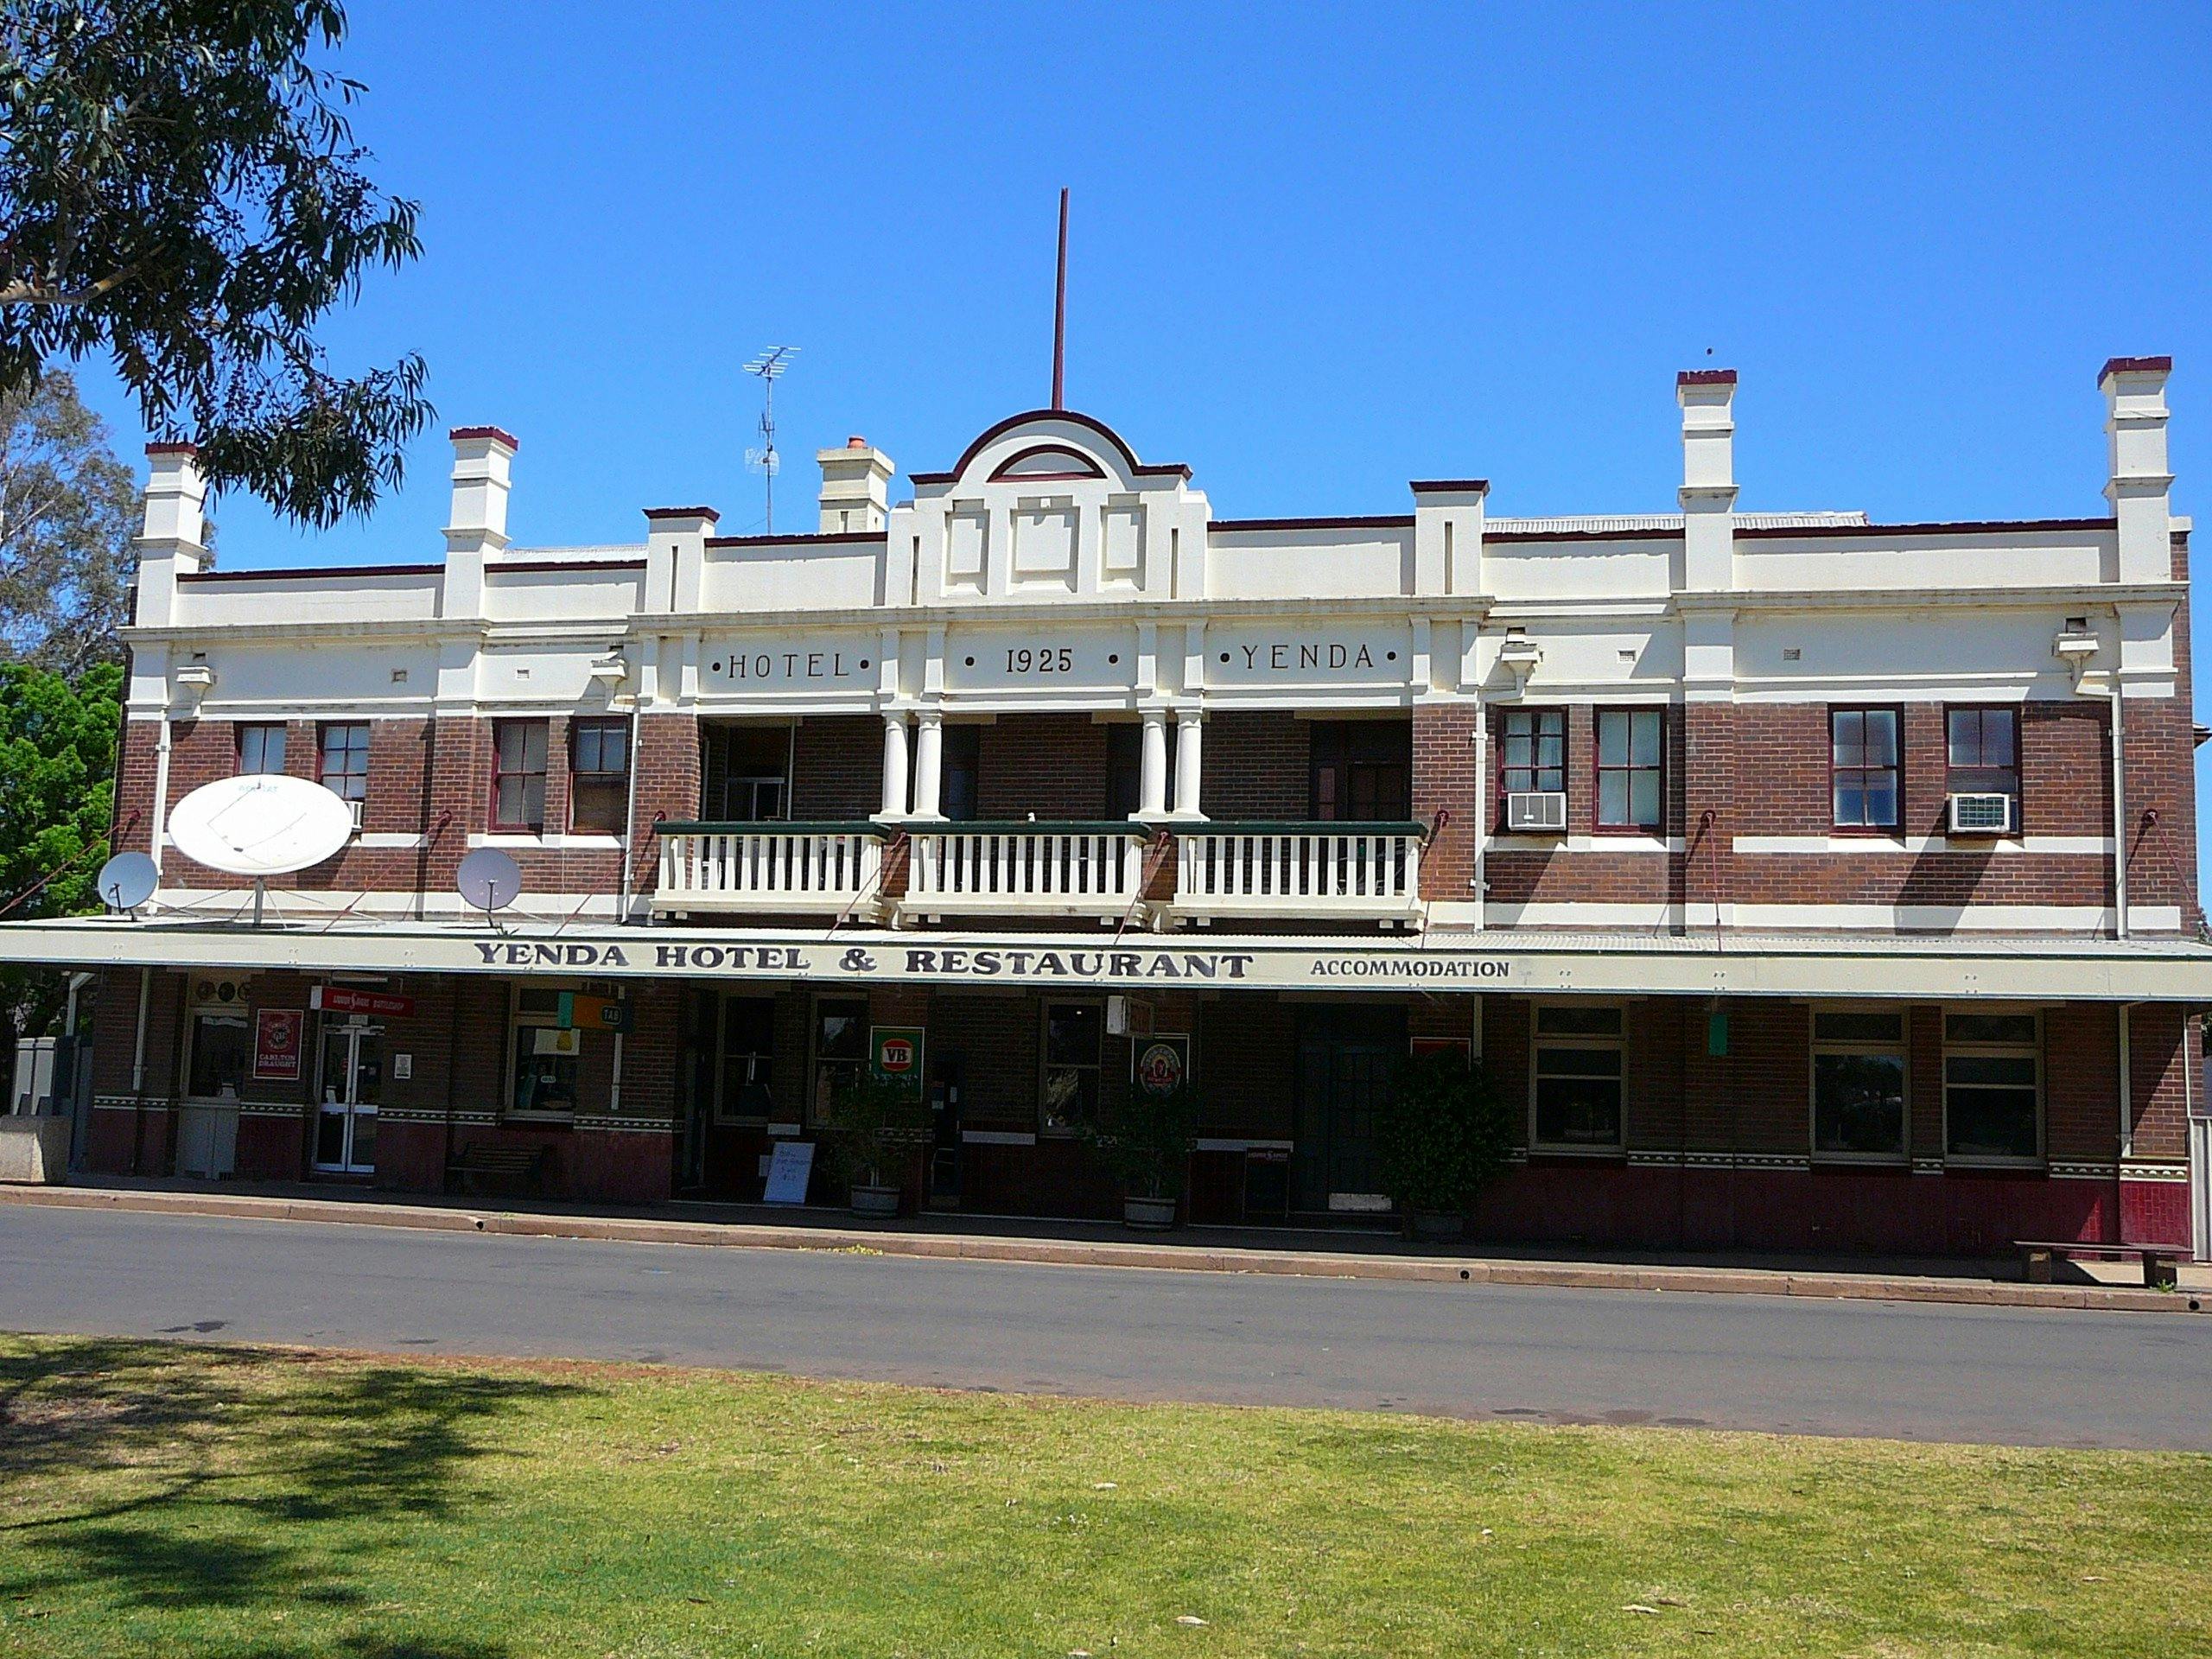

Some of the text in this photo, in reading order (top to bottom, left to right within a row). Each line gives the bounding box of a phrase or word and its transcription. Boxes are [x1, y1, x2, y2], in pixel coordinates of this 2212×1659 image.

[728, 653, 849, 678] HOTEL
[1006, 648, 1073, 673] 1925
[1241, 644, 1374, 670] YENDA
[473, 942, 1255, 979] YENDA HOTEL & RESTAURANT
[1310, 959, 1510, 977] ACCOMMODATION
[604, 1008, 619, 1021] TAB
[887, 1047, 908, 1062] VB
